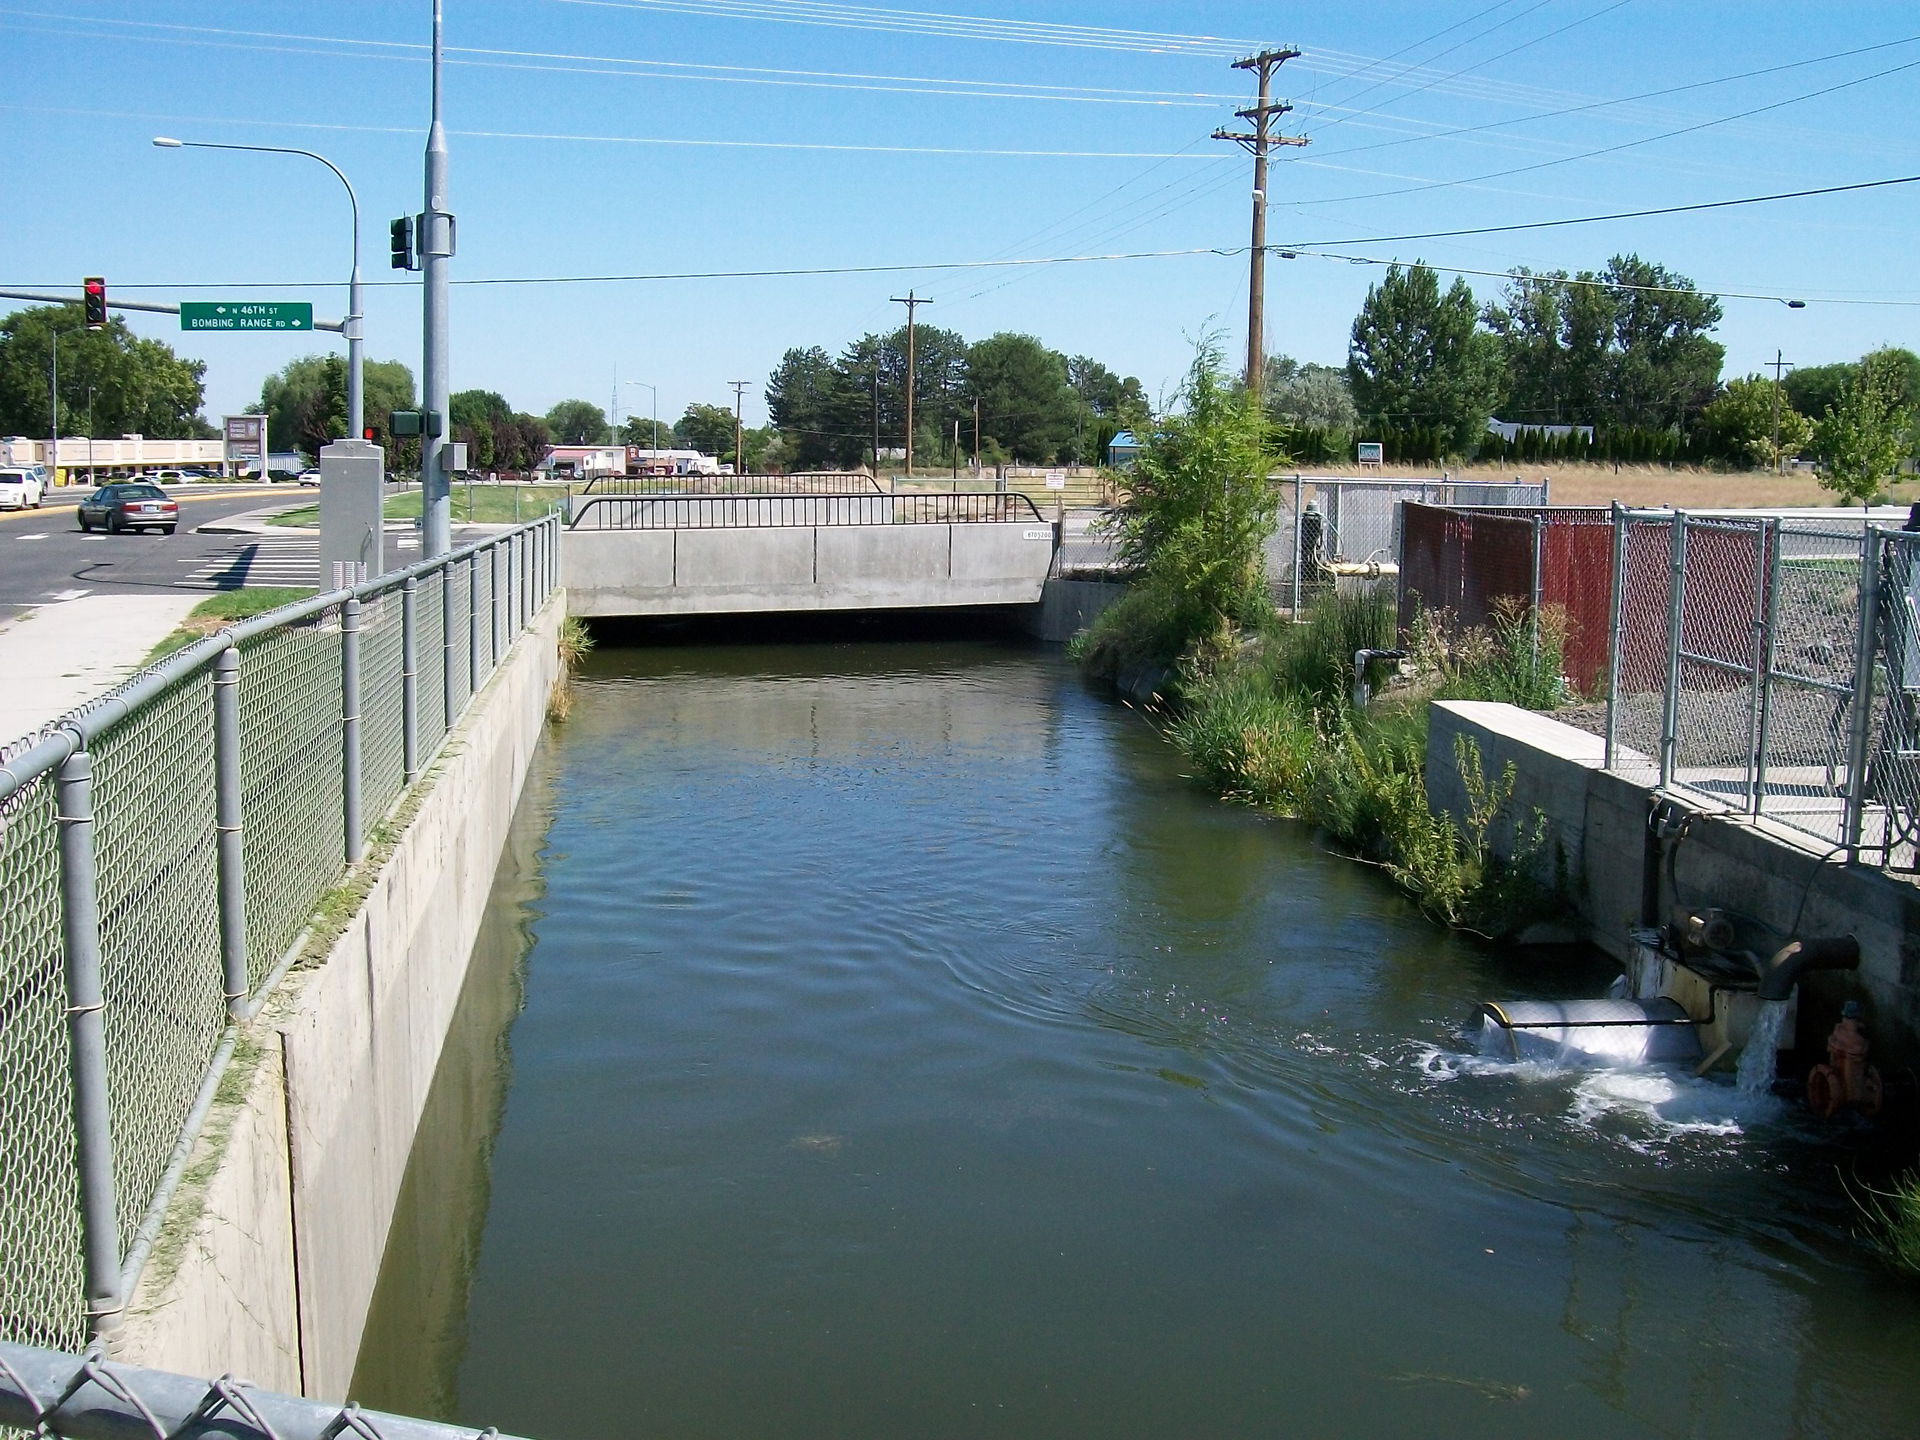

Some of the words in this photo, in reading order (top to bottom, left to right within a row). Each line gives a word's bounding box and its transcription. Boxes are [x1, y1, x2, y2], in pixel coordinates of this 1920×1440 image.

[240, 305, 266, 315] 46TH
[191, 318, 234, 328] BOMBING
[240, 318, 273, 328] RANGE
[275, 320, 286, 328] RD
